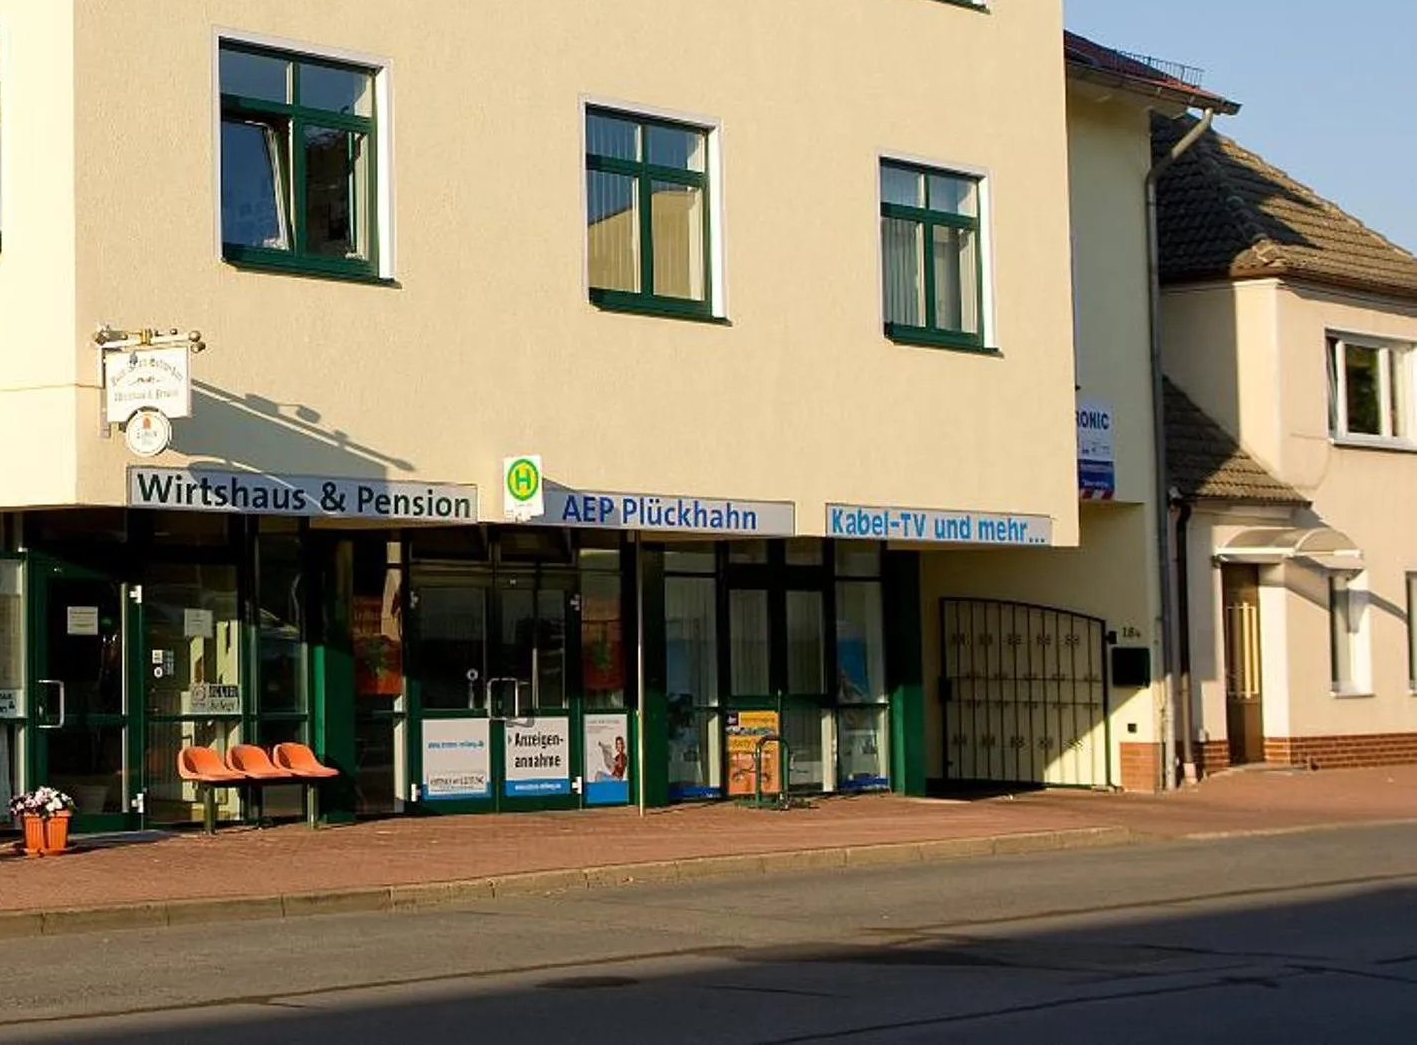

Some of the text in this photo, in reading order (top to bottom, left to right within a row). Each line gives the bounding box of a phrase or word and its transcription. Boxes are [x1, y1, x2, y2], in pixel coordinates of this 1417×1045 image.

[515, 468, 531, 491] H
[136, 472, 307, 511] Wirtshaus
[320, 481, 346, 512] &
[357, 486, 471, 518] Pension
[562, 495, 757, 530] AEP Plückhahn
[832, 508, 927, 538] Kabel-TV
[934, 516, 971, 540] und
[514, 731, 564, 749] Anzeigen-
[514, 753, 562, 768] annahme
